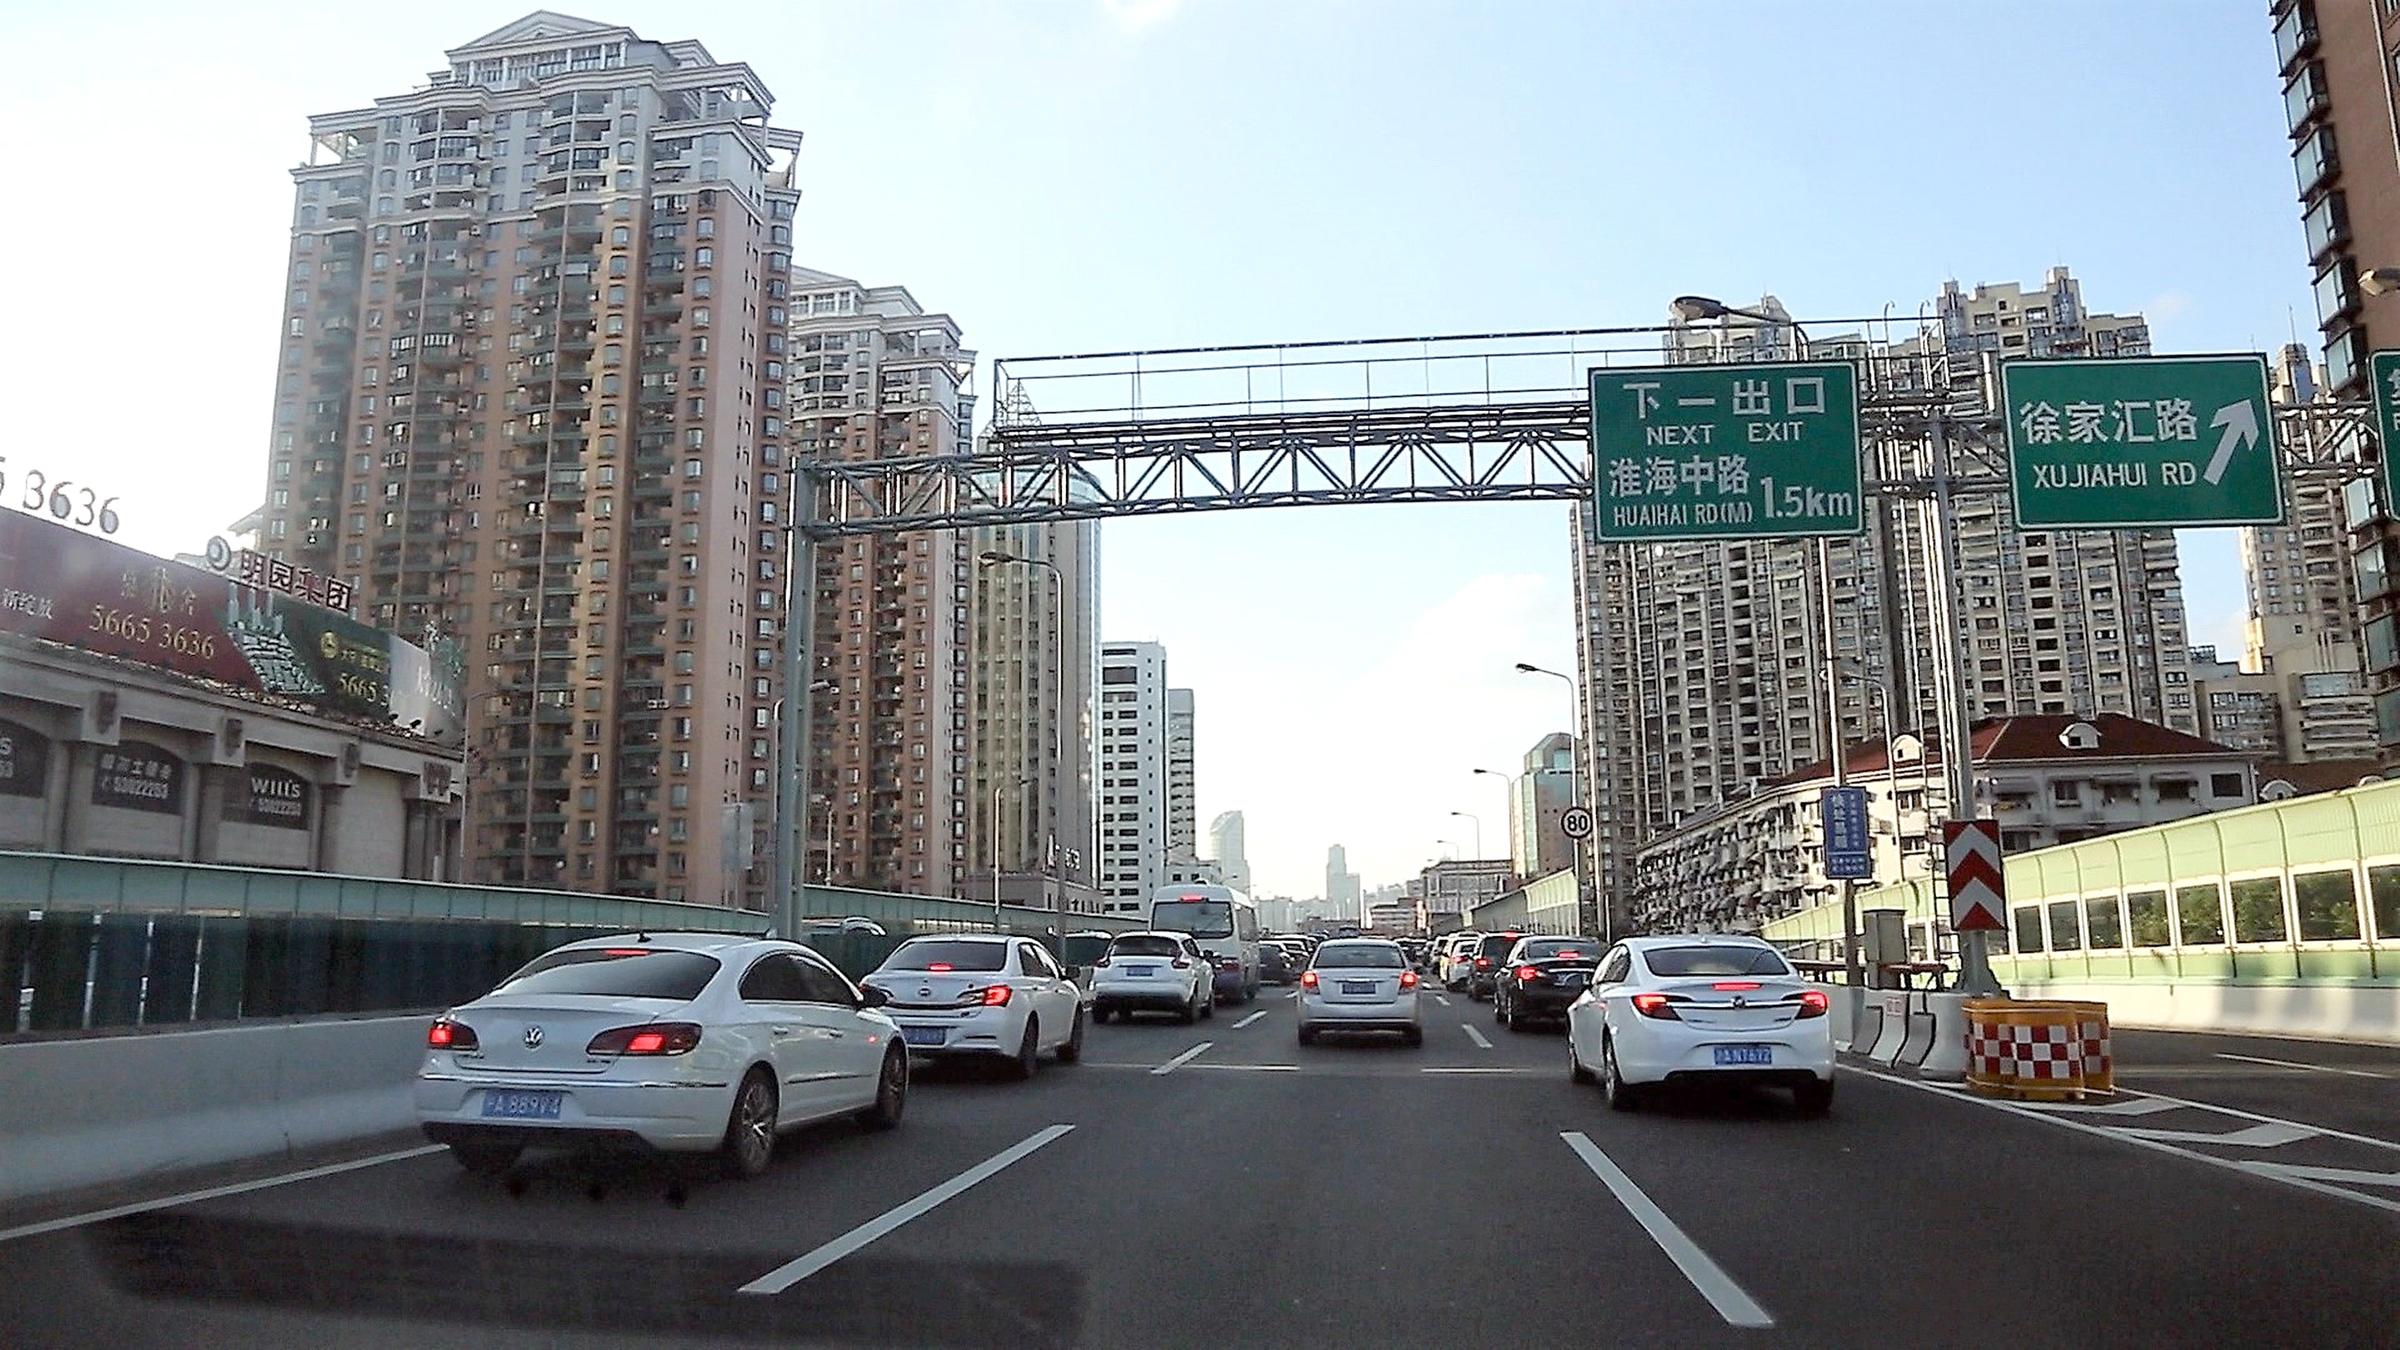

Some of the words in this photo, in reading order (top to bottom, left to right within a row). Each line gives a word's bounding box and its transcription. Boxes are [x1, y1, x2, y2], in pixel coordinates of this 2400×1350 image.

[1623, 377, 1825, 419] 下一出口
[1647, 424, 1715, 446] NEXT
[1749, 421, 1803, 443] EXIT
[2020, 398, 2198, 445] 徐家汇路
[1608, 454, 1750, 498] 淮海中路
[2034, 463, 2147, 489] XUJIAHUI
[2162, 461, 2197, 486] RD
[22, 469, 120, 534] 3636
[1614, 503, 1687, 528] HUAIHAI
[1696, 502, 1753, 525] RD(M)
[1760, 477, 1851, 519] 1.5km
[241, 548, 352, 615] 明园集团
[89, 604, 151, 643] 5665
[159, 622, 214, 660] 3636
[1567, 815, 1588, 831] 80
